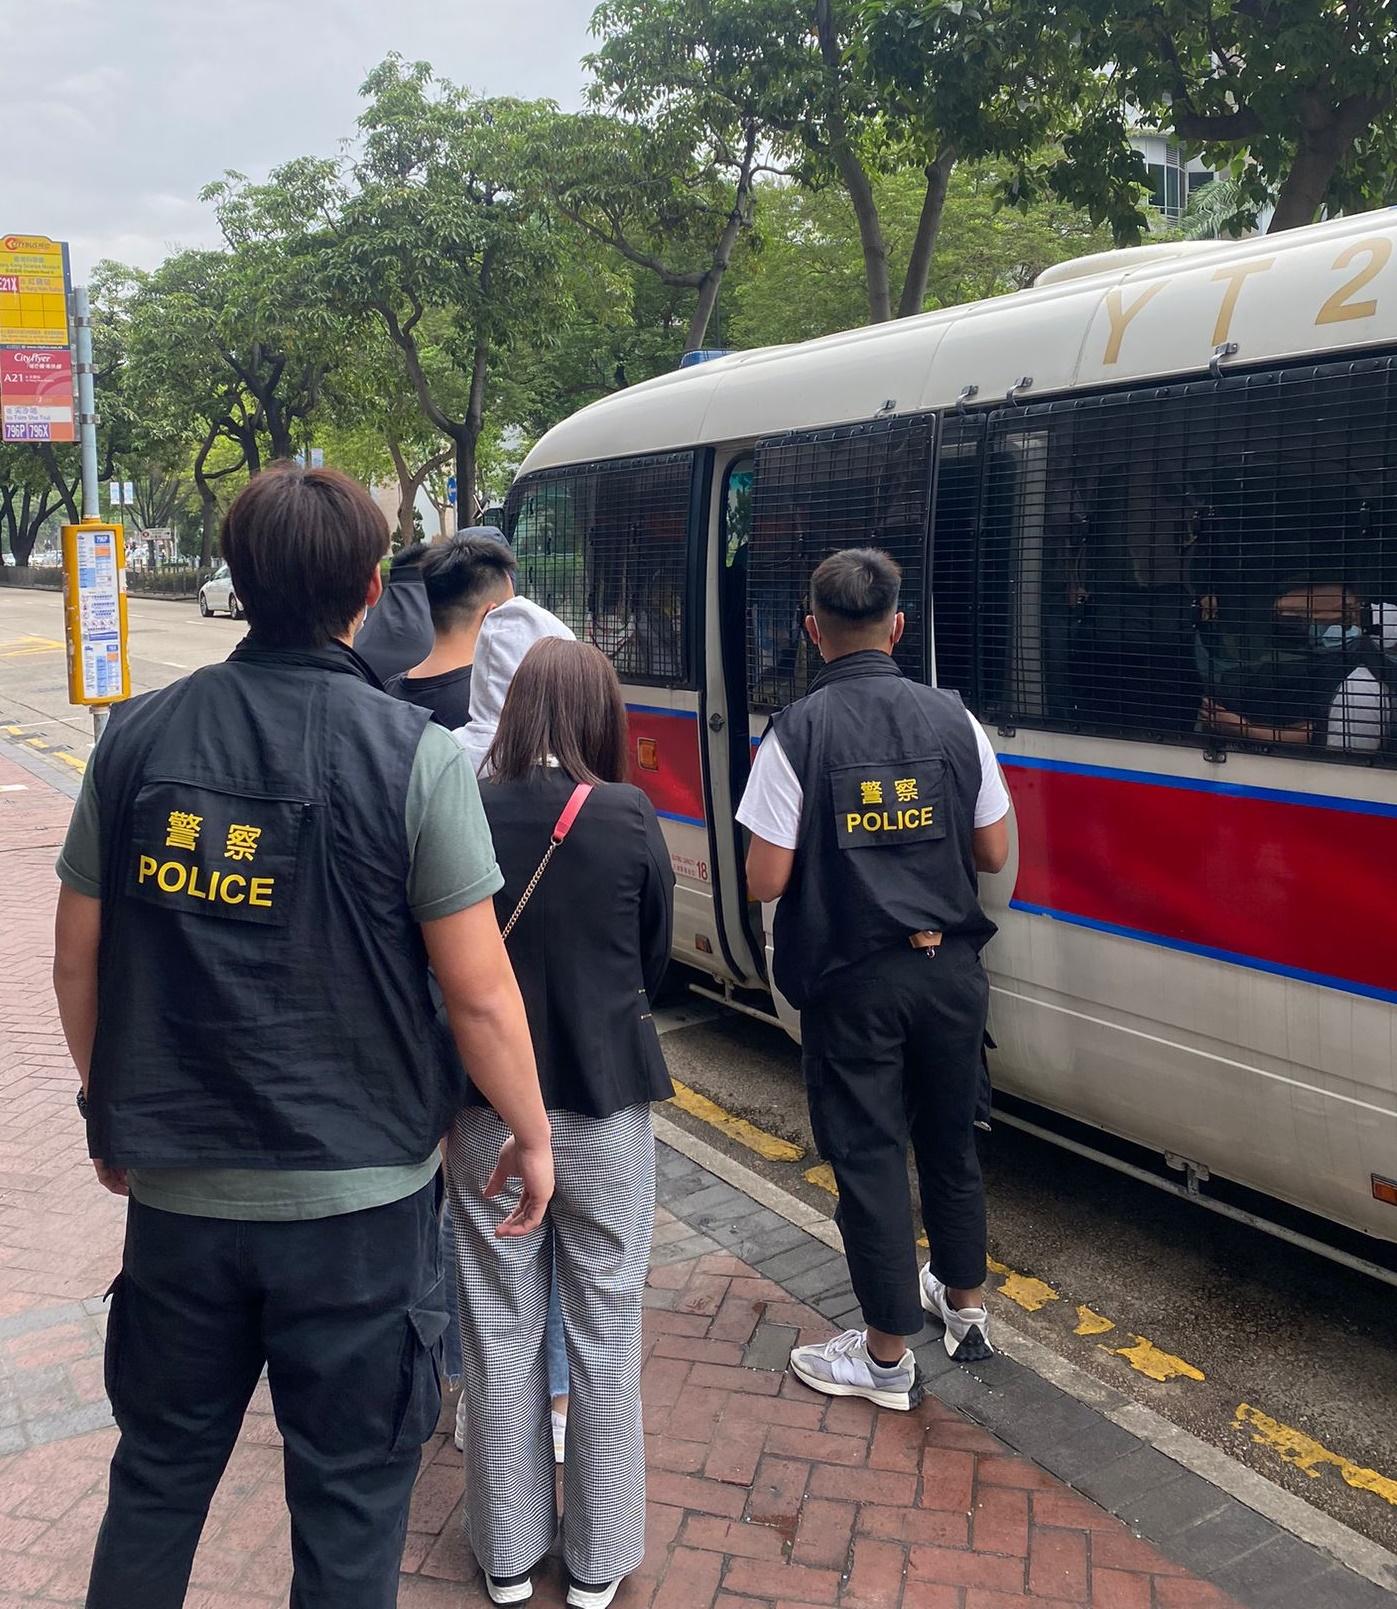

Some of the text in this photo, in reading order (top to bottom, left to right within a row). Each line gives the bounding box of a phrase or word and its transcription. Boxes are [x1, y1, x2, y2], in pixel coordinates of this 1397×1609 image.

[4, 373, 23, 382] A21
[6, 424, 49, 438] 796P 796X
[846, 806, 934, 833] POLICE
[697, 861, 708, 880] 18
[138, 854, 275, 908] POLICE
